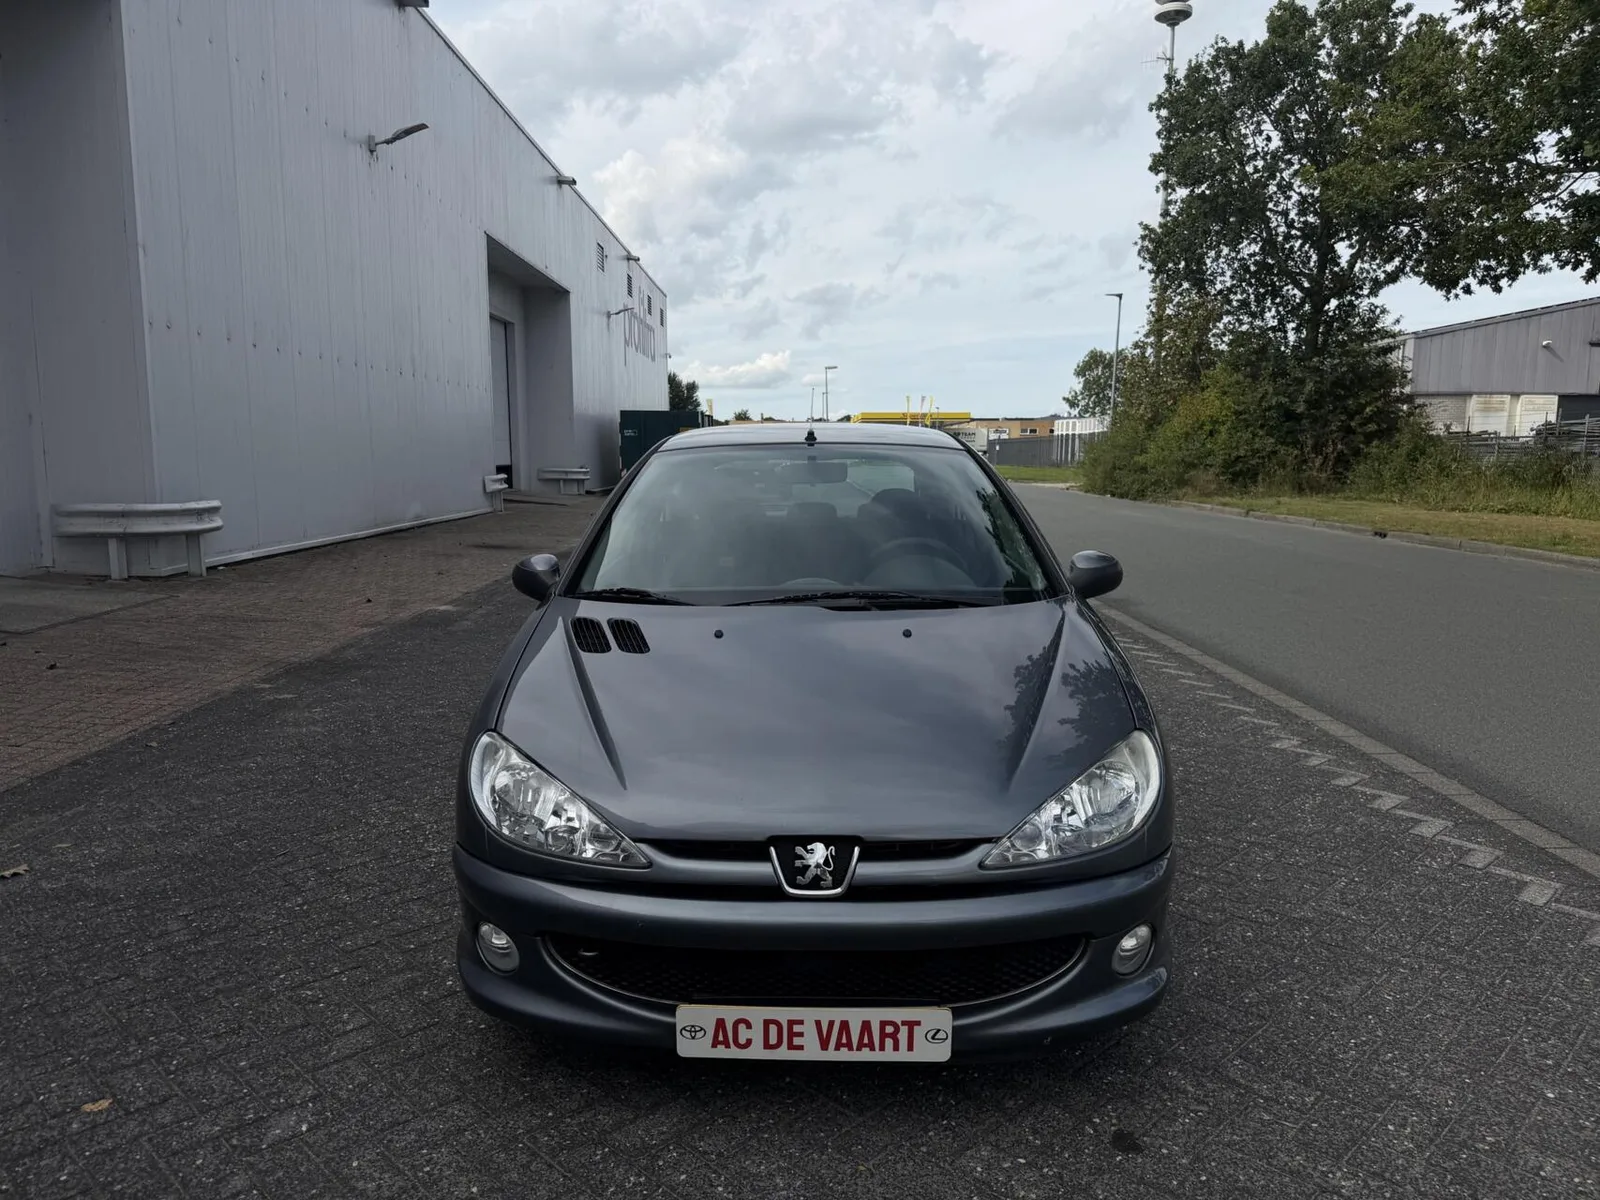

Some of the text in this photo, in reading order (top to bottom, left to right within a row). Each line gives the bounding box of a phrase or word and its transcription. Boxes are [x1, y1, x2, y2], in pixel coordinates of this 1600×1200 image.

[710, 1017, 922, 1052] AC DE VAART
